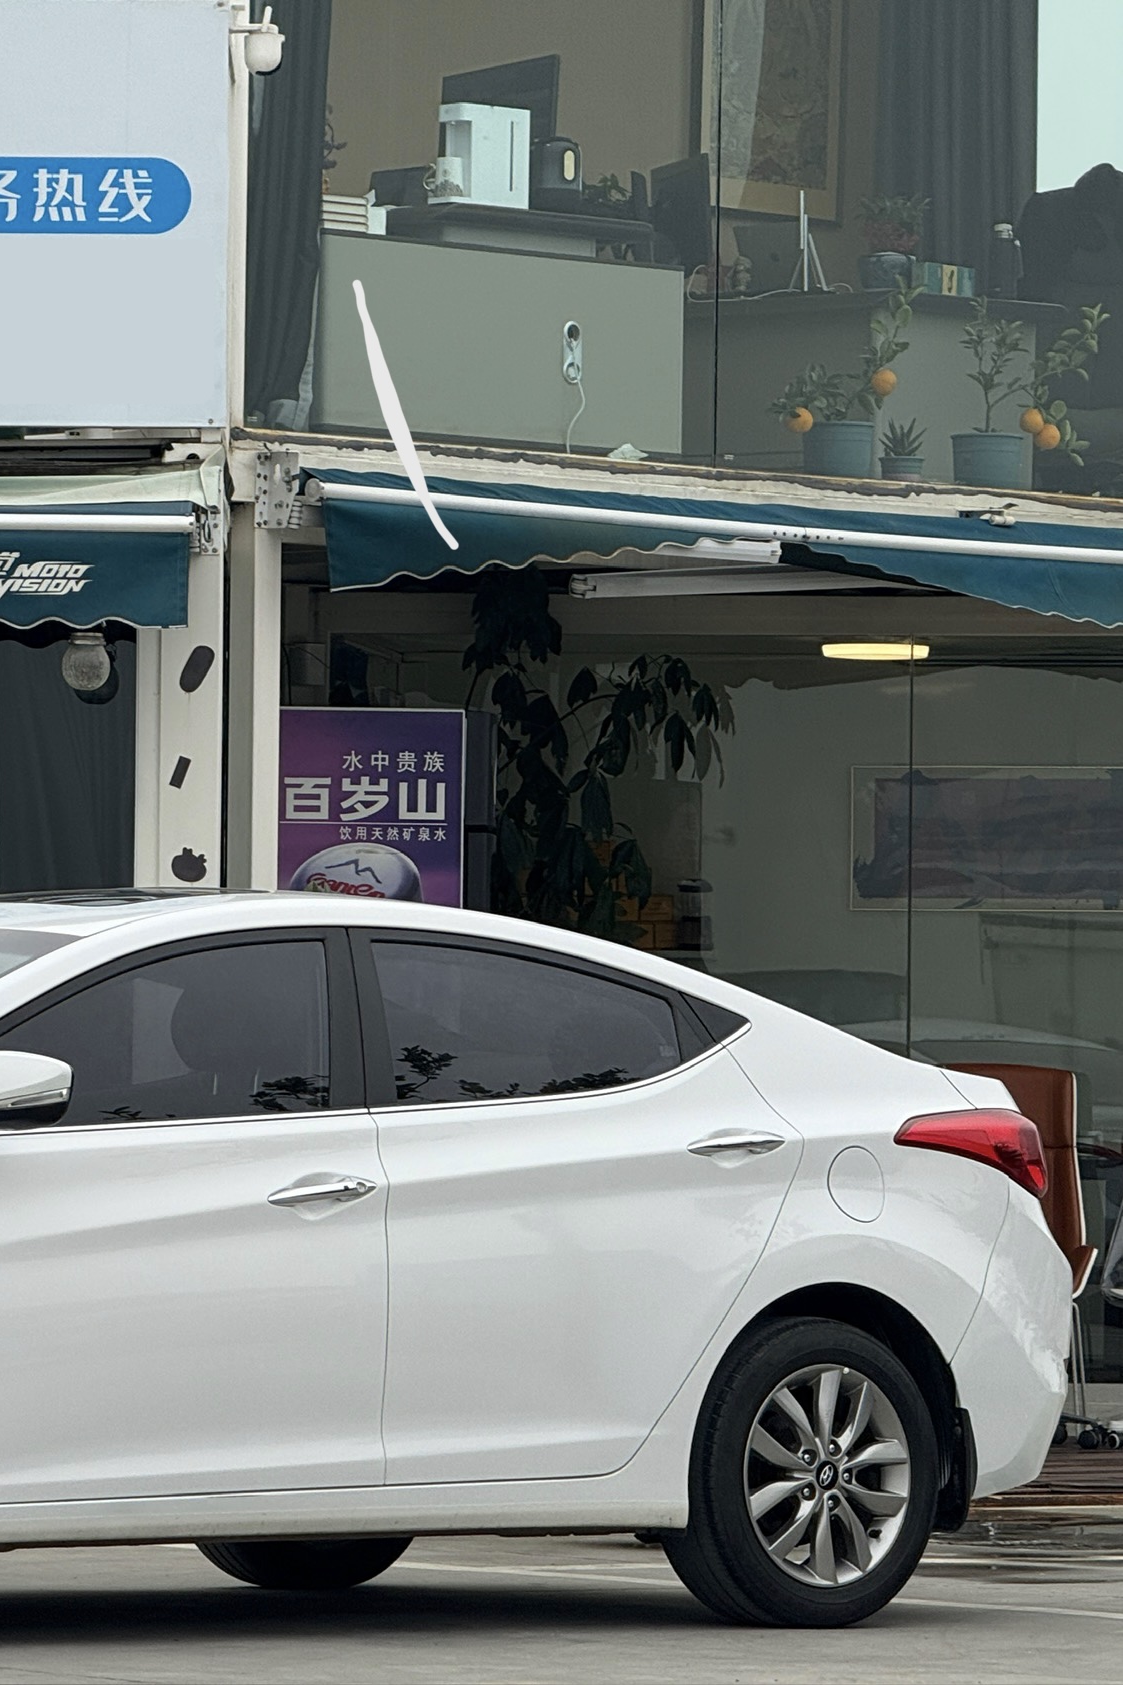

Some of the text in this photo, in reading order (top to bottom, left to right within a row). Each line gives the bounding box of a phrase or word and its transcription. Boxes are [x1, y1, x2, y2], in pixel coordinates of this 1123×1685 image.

[10, 561, 95, 578] MOTO
[342, 750, 445, 773] 水中贵族
[283, 775, 447, 822] 百岁山
[339, 826, 447, 843] 饮用天然矿泉水
